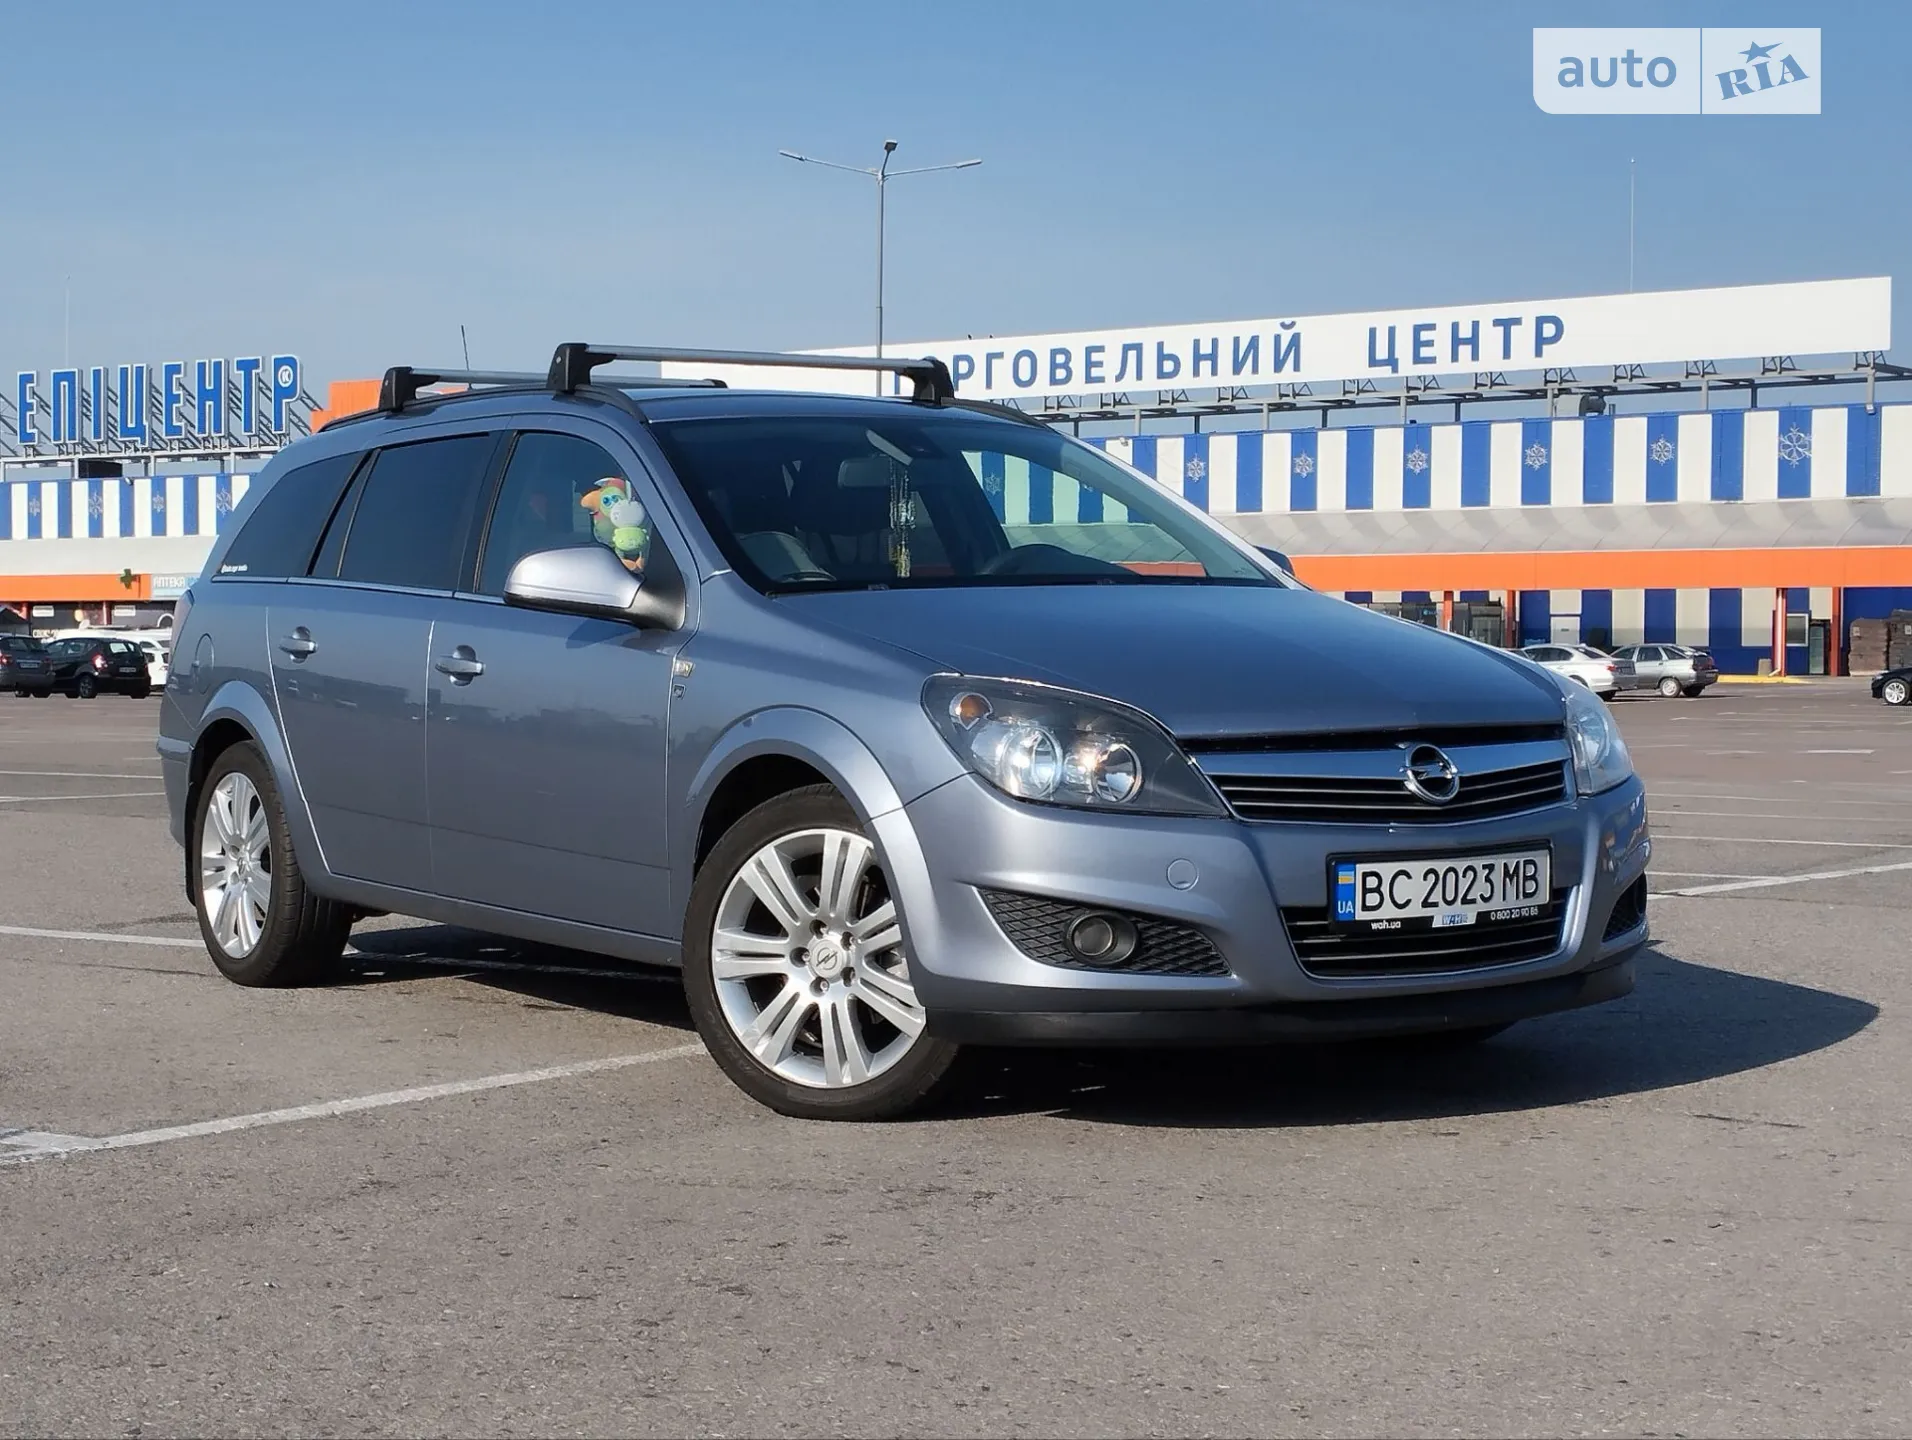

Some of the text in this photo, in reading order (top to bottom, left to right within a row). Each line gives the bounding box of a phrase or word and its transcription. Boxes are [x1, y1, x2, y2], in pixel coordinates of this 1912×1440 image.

[894, 315, 1565, 395] РГОВЕЛЬНИЙ ЦЕНТР
[17, 354, 300, 447] ЕПІЦЕНТР
[1337, 900, 1354, 914] UA
[1361, 858, 1539, 912] BC 2023 MB
